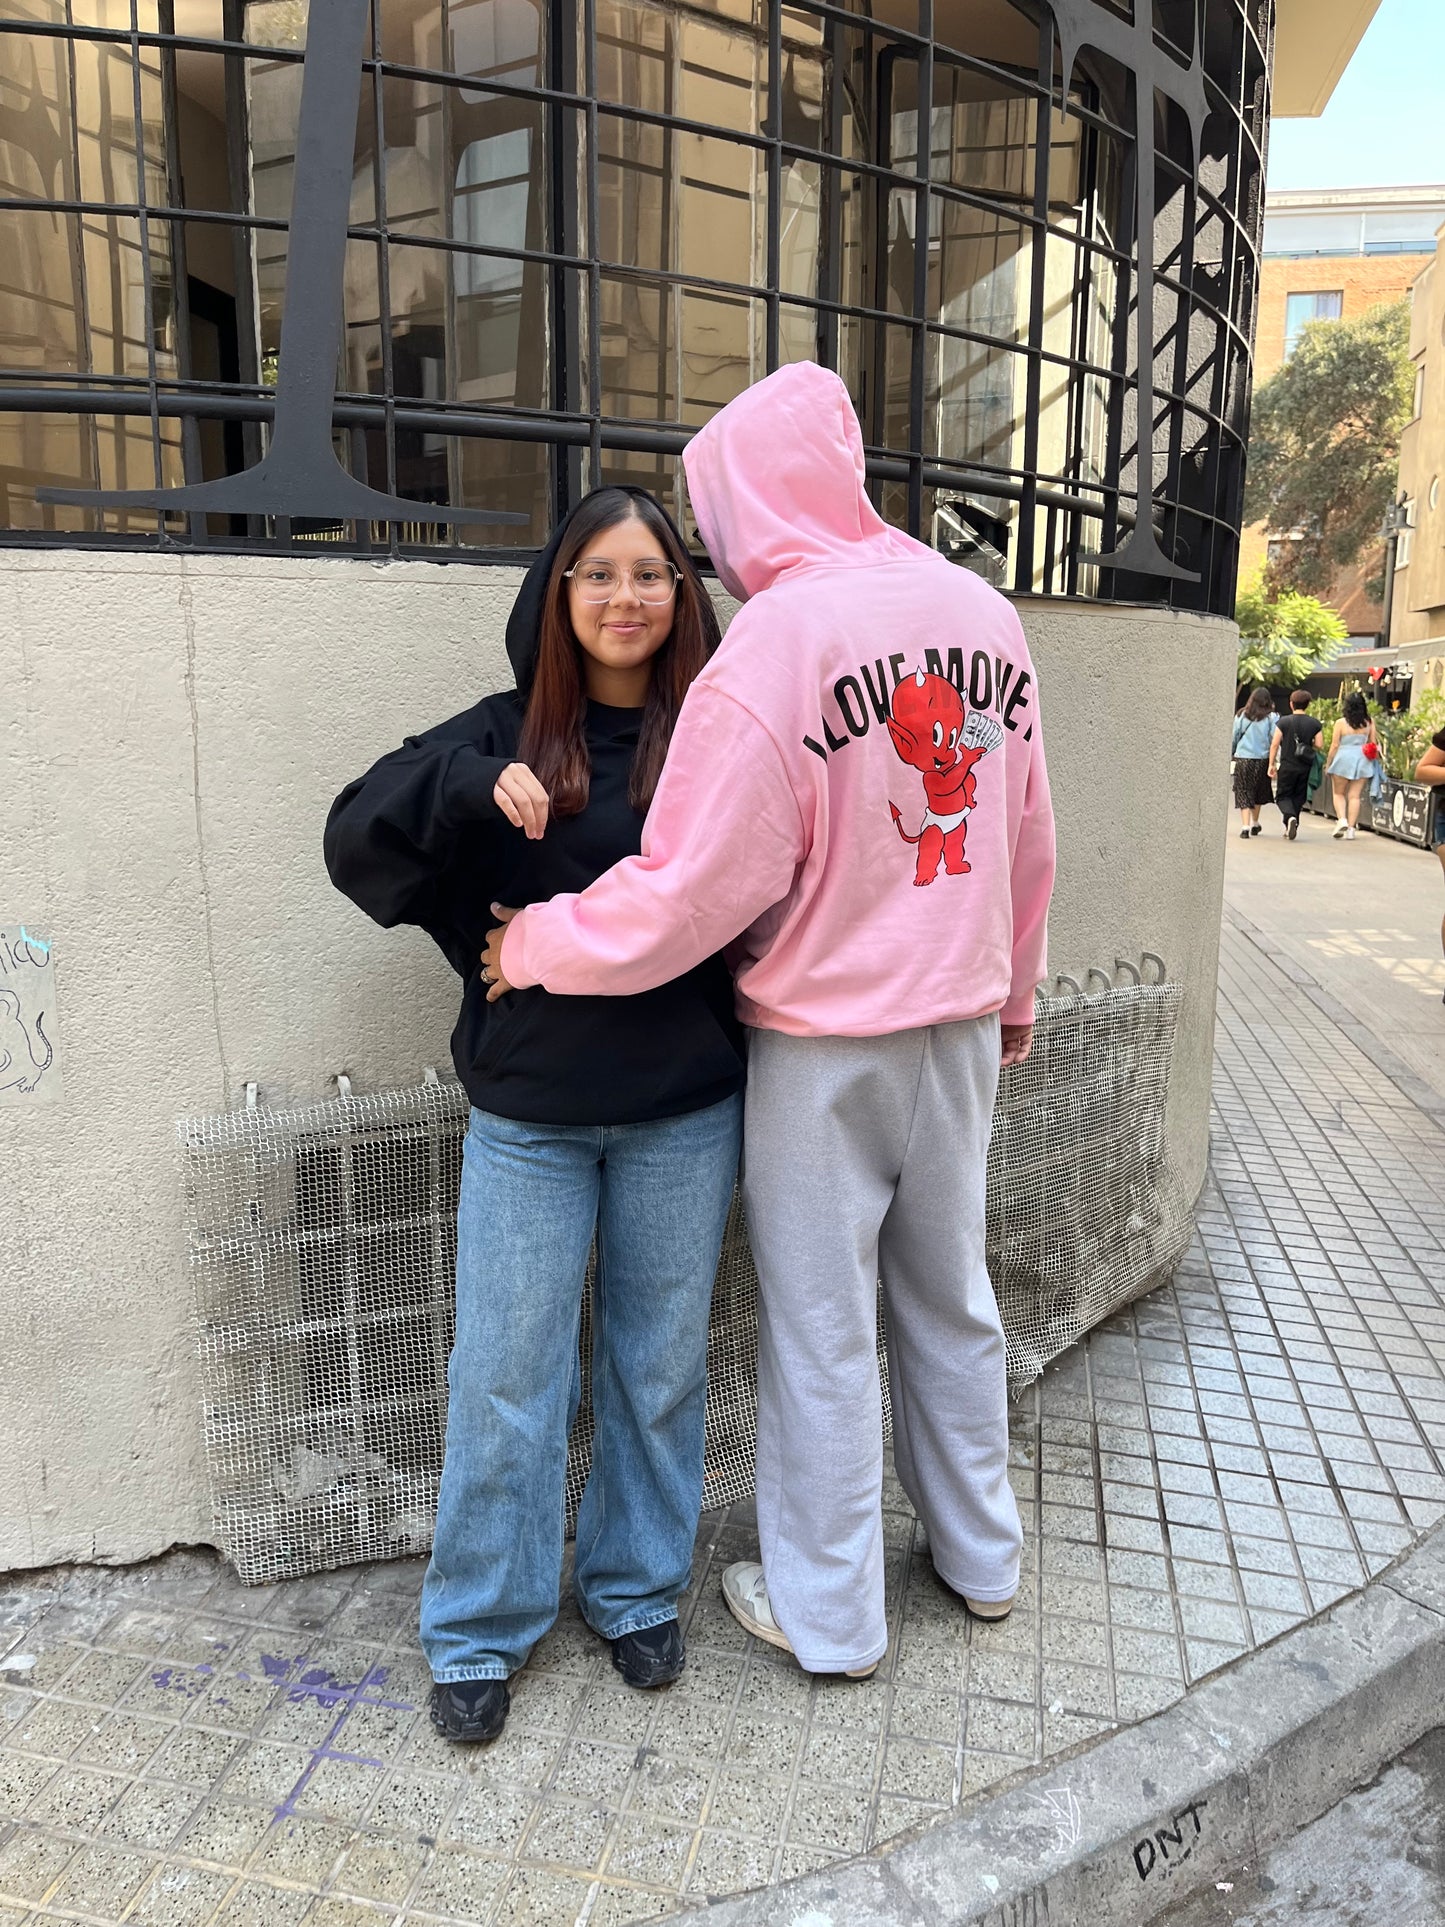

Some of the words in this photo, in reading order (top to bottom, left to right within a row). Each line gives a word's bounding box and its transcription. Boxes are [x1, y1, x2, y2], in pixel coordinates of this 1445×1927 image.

[821, 652, 906, 753] LOVE
[924, 647, 1033, 743] MONE
[1133, 1800, 1208, 1882] DNT
